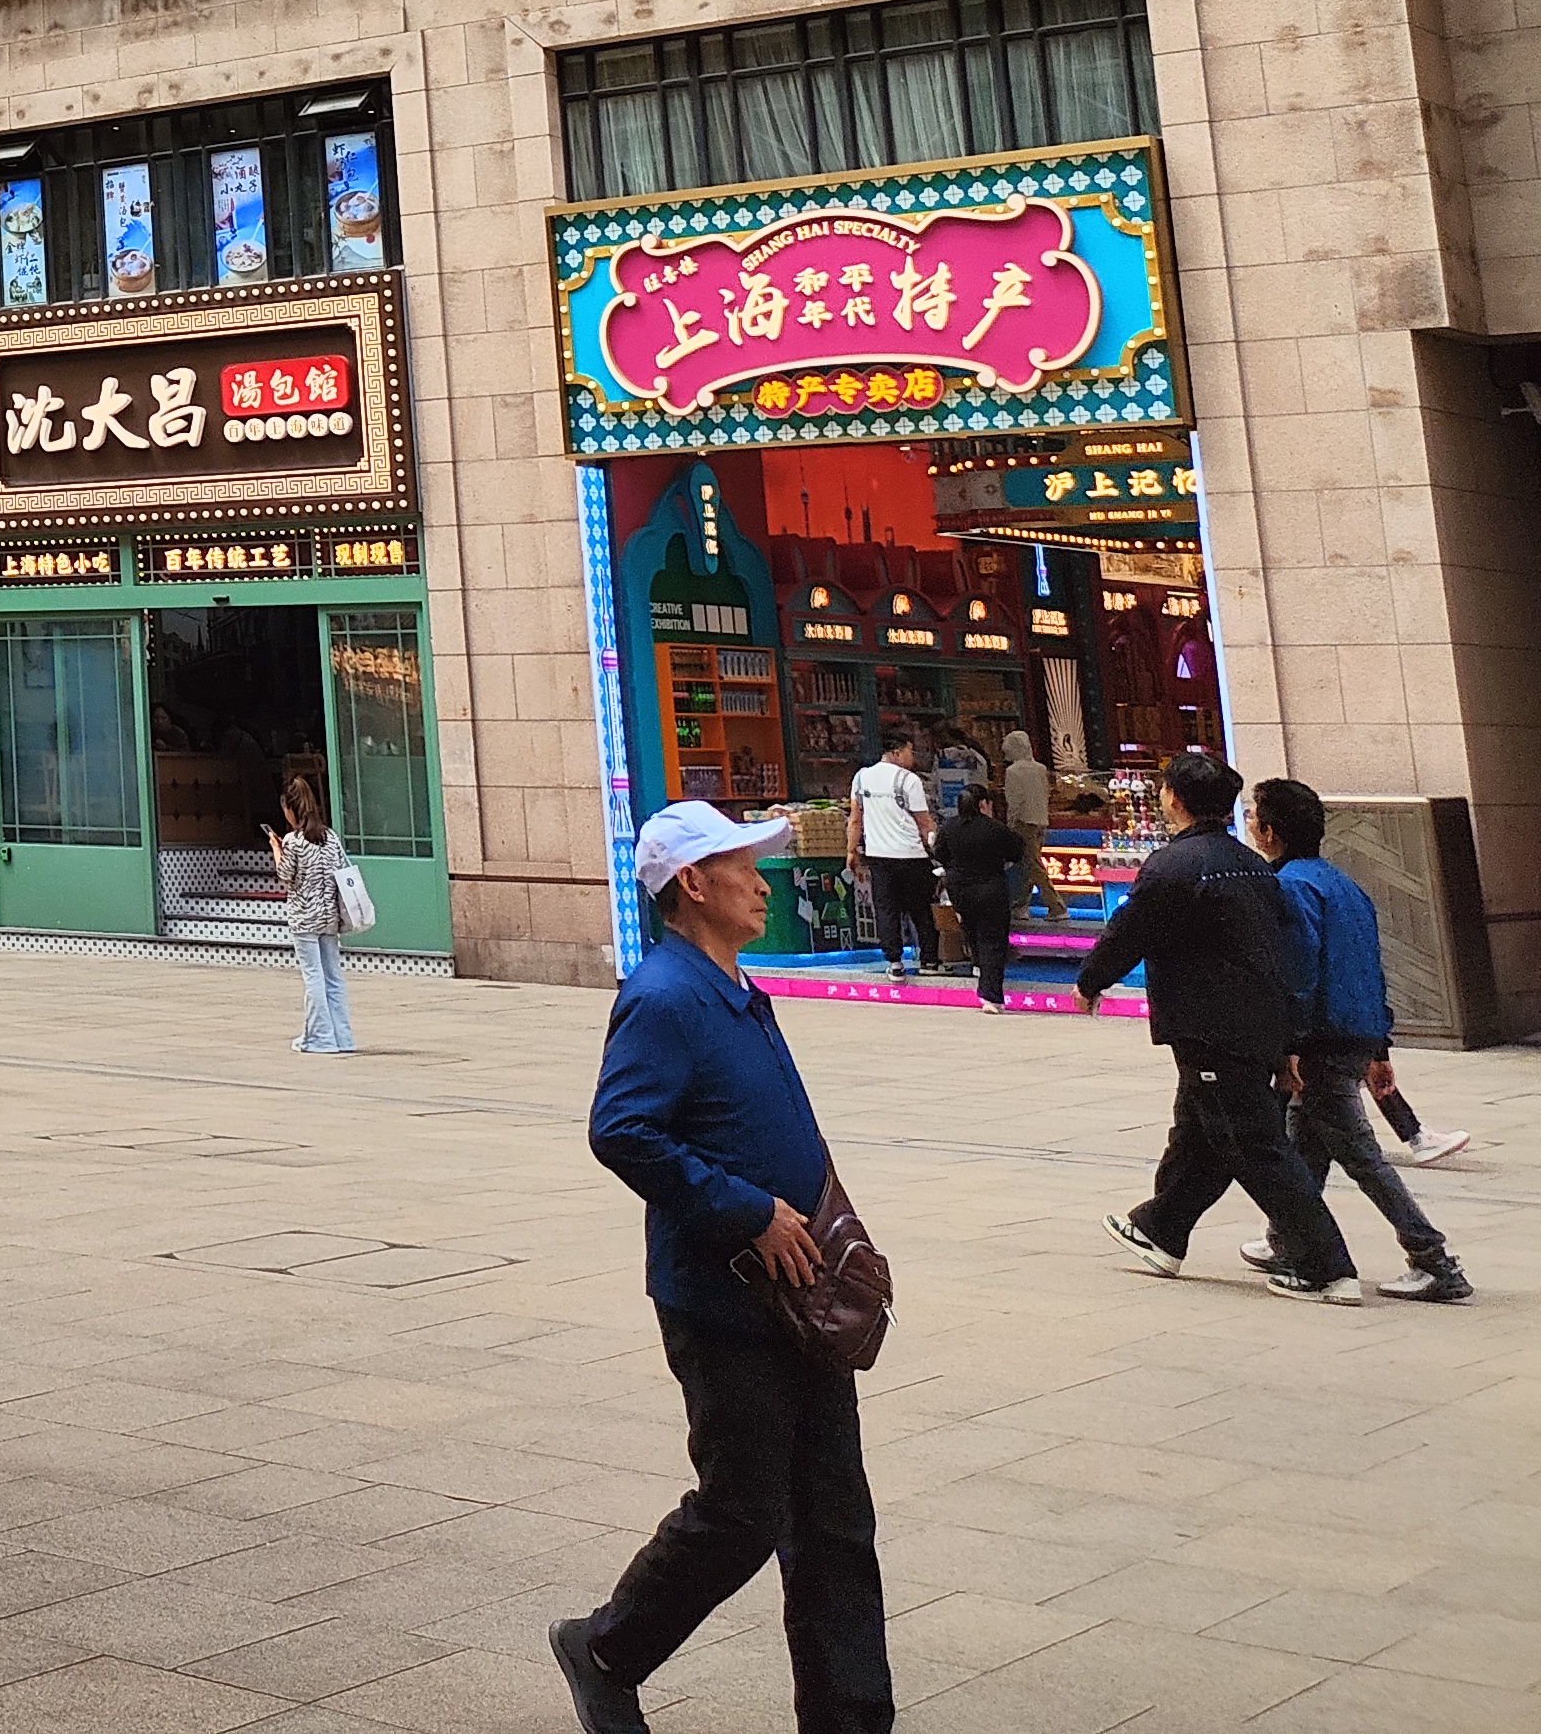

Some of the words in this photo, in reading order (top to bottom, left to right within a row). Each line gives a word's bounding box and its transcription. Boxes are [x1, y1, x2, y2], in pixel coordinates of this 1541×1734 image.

[741, 232, 795, 272] SHANG
[797, 221, 828, 242] HAI
[833, 220, 923, 255] SPECIALTY
[793, 263, 875, 297] 和平
[655, 270, 790, 370] 上海
[890, 255, 1033, 351] 特产
[795, 296, 876, 330] 年代
[756, 367, 939, 411] 特产专卖店
[5, 367, 209, 455] 沈大昌
[227, 415, 347, 439] 百年上海味道
[1084, 443, 1133, 456] SHANG
[1136, 442, 1163, 453] HAI
[1043, 467, 1198, 502] 沪上记忆
[2, 551, 111, 577] 上海特色小吃
[164, 544, 292, 572] 百年传统工艺
[334, 539, 404, 566] 现制现售
